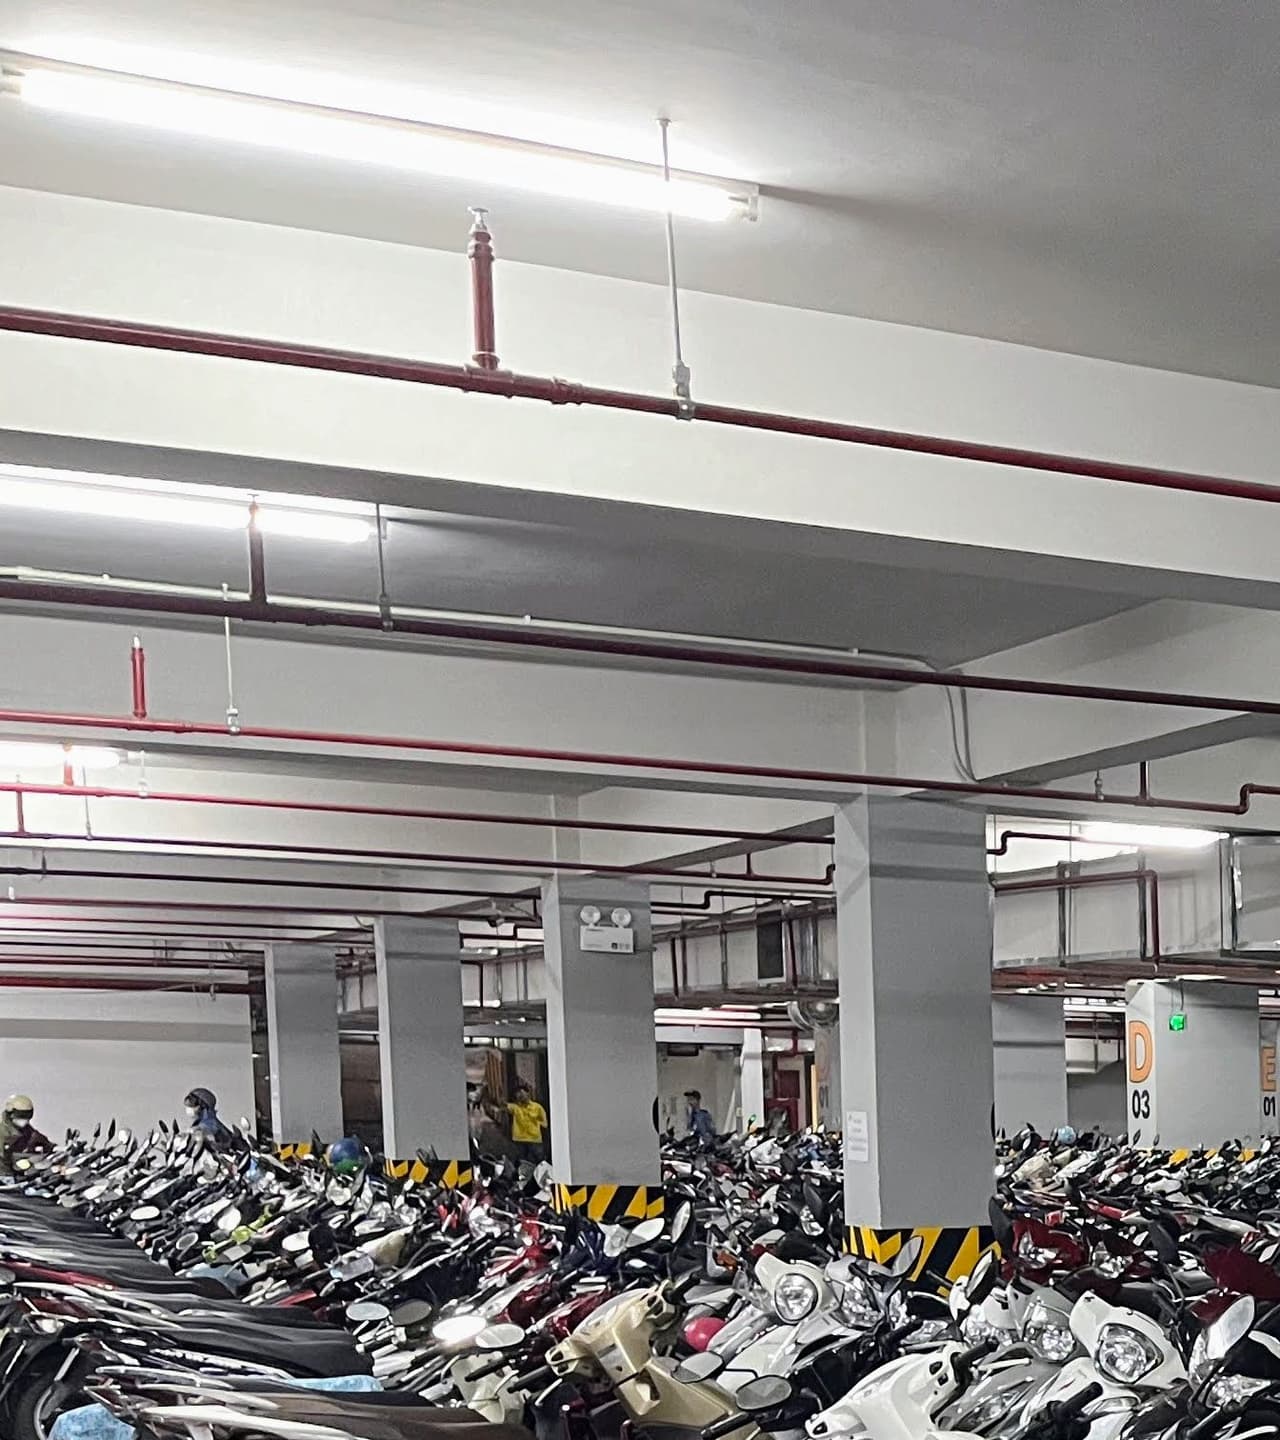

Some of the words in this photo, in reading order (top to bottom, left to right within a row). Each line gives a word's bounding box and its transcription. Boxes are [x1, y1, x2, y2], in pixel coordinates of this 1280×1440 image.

[1128, 1020, 1153, 1083] D
[1260, 1046, 1277, 1092] E
[1131, 1089, 1151, 1119] 03
[1262, 1096, 1276, 1117] 01
